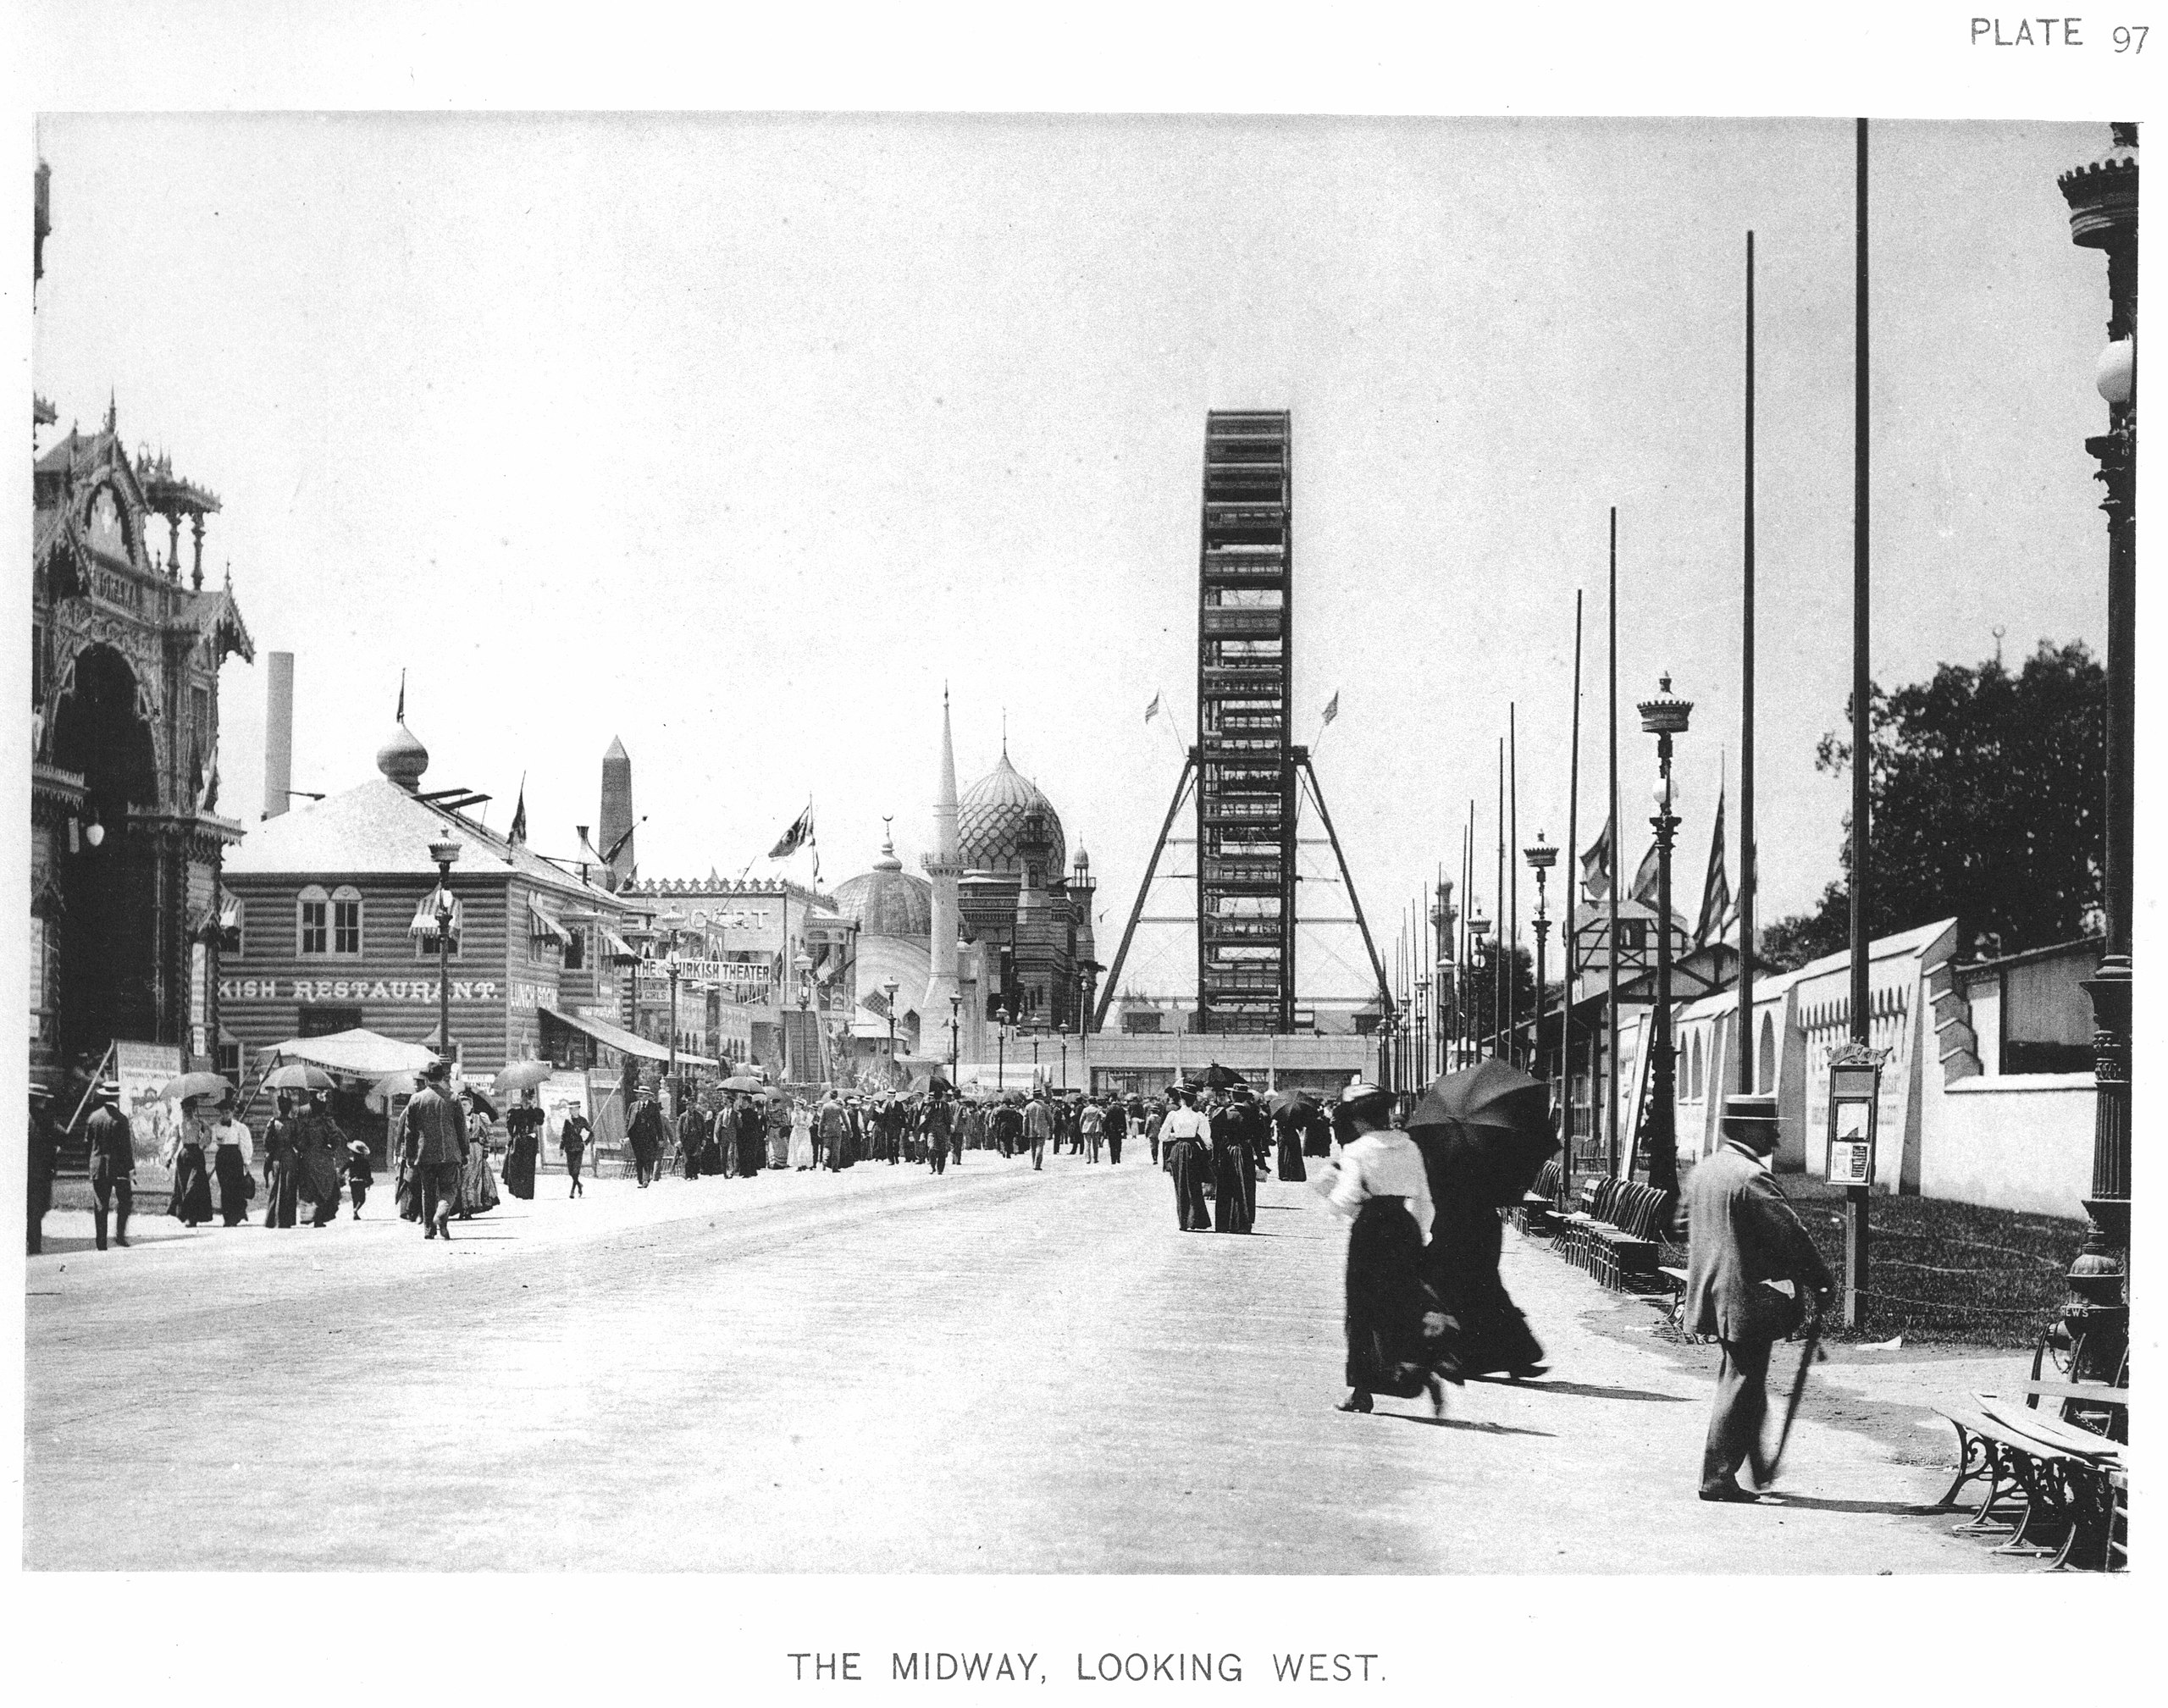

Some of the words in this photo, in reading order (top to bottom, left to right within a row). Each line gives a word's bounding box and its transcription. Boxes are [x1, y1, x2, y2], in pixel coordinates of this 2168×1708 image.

[674, 962, 720, 981] URKISH
[722, 965, 770, 983] THEATER
[644, 991, 666, 1000] GIRLS
